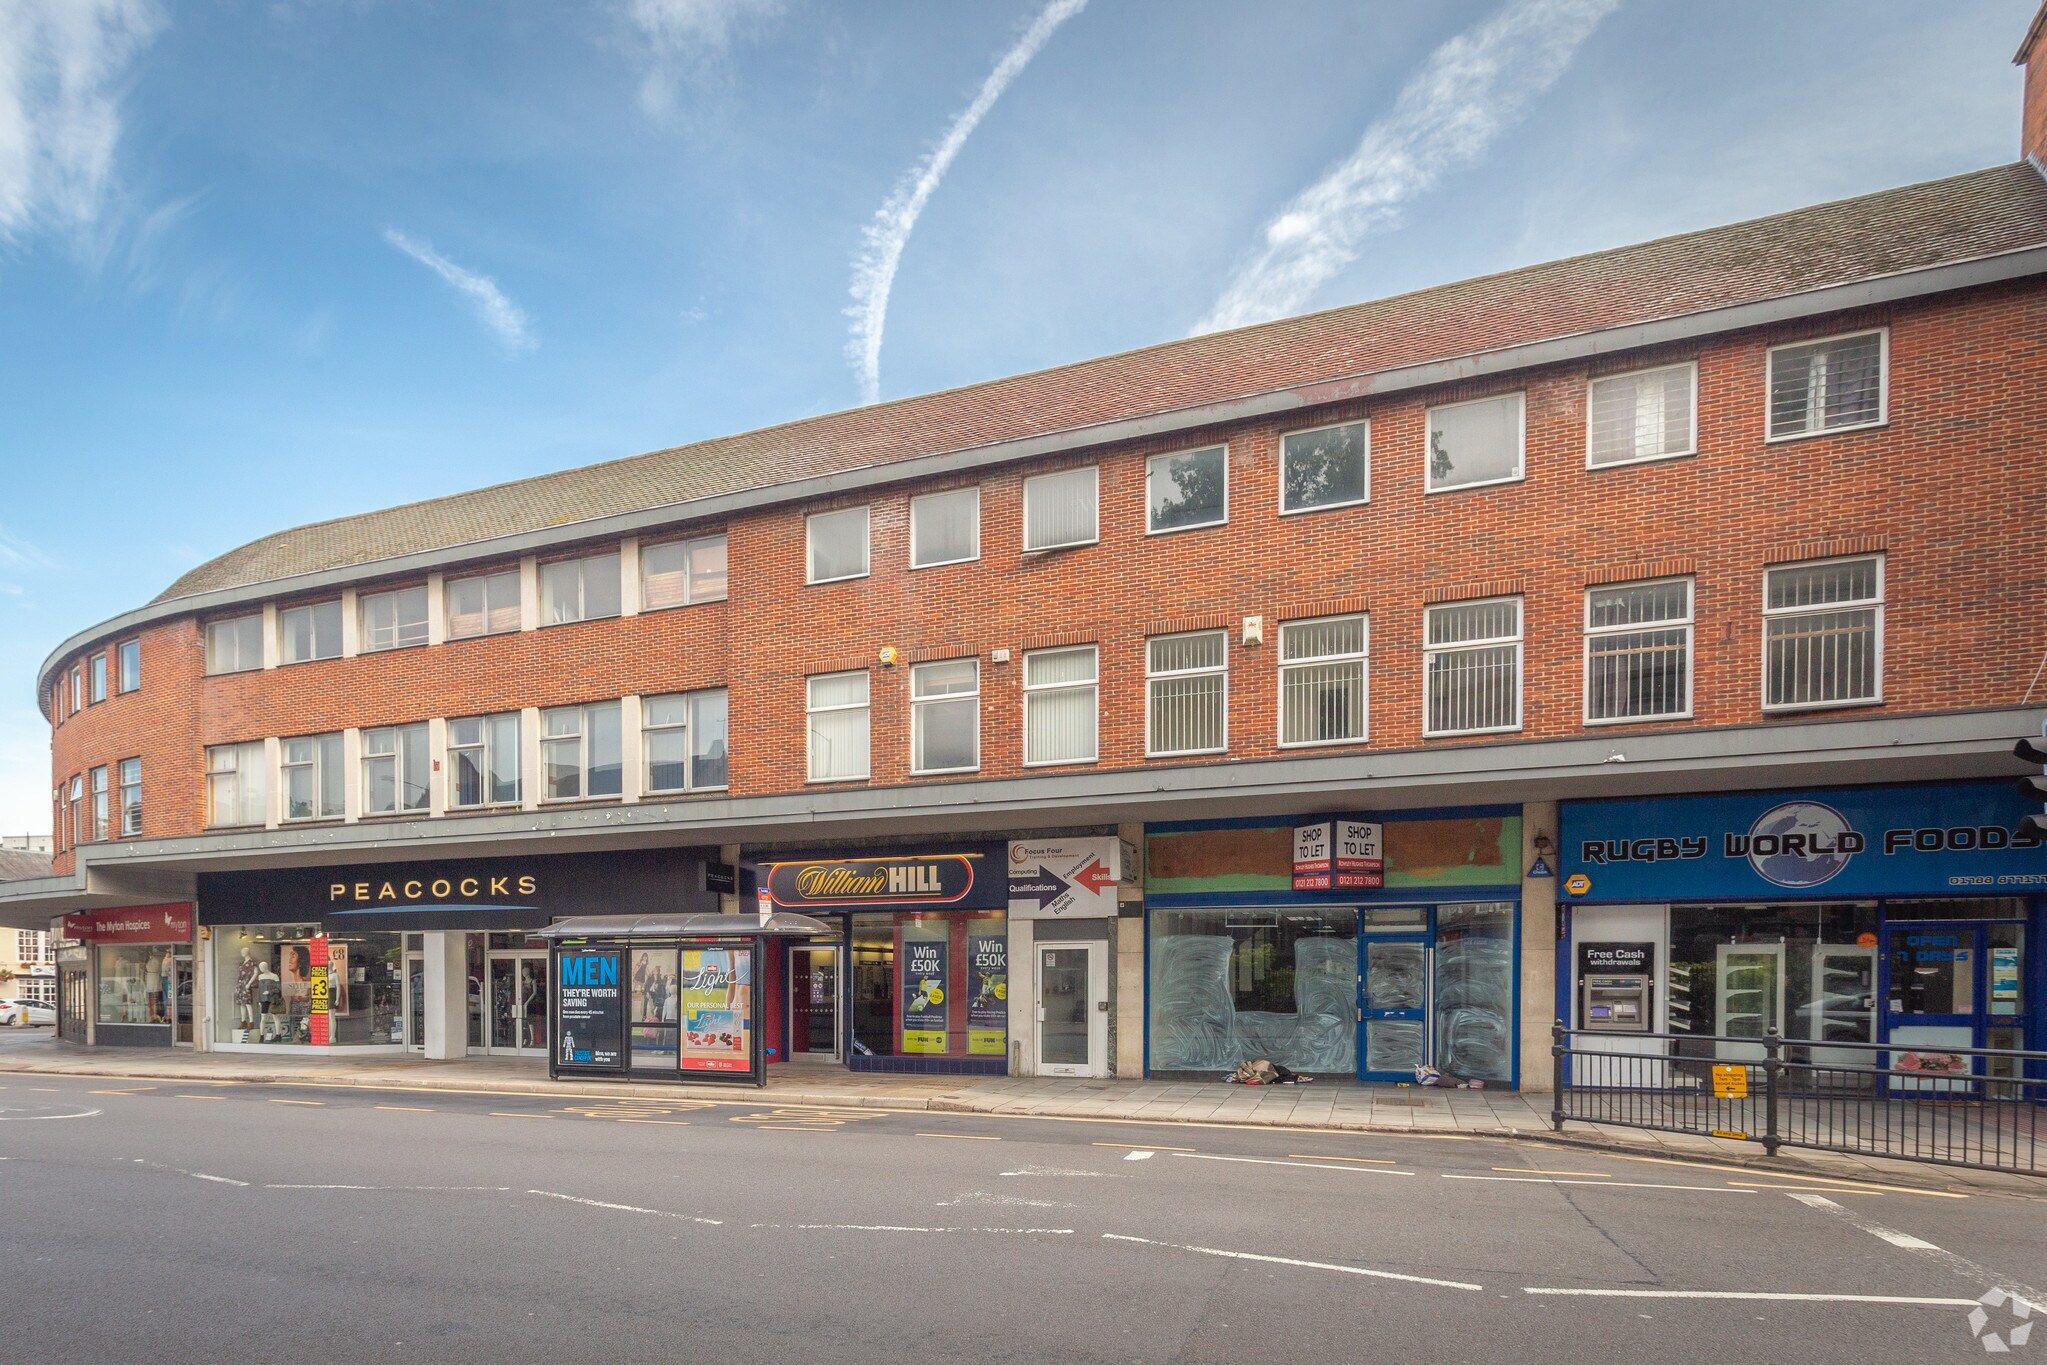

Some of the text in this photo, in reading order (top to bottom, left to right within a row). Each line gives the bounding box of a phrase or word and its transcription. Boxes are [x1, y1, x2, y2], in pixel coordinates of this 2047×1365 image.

[1302, 828, 1322, 842] SHOP
[1348, 826, 1371, 839] SHOP
[1299, 844, 1324, 858] TO LET
[1344, 842, 1375, 855] TO LET
[1582, 836, 1707, 864] RUGBY
[1724, 831, 1865, 858] WORLD
[1062, 852, 1096, 880] Employment
[796, 866, 941, 896] William HILL
[1296, 879, 1305, 887] 0121
[1315, 878, 1328, 886] 7800
[1340, 876, 1352, 884] 0121
[1354, 876, 1363, 885] 212
[1949, 876, 1993, 885] 01788
[330, 876, 536, 900] PEACOCKS
[1009, 884, 1057, 892] Qualifications
[1051, 892, 1069, 908] Maths
[1054, 896, 1076, 915] English
[96, 920, 150, 933] The Myton Hospices
[979, 940, 1002, 952] Win
[1906, 936, 1959, 946] OPEN
[333, 948, 345, 960] £8
[914, 946, 936, 958] Win
[1587, 949, 1644, 958] Free Cash
[1916, 950, 1969, 962] DAYS
[911, 960, 940, 971] £50K
[976, 954, 1006, 966] £50K
[562, 956, 616, 986] MEN
[313, 980, 327, 995] £3
[684, 967, 748, 996] Light
[563, 989, 616, 997] THEY'RE WORTH
[730, 1109, 890, 1126] BUS
